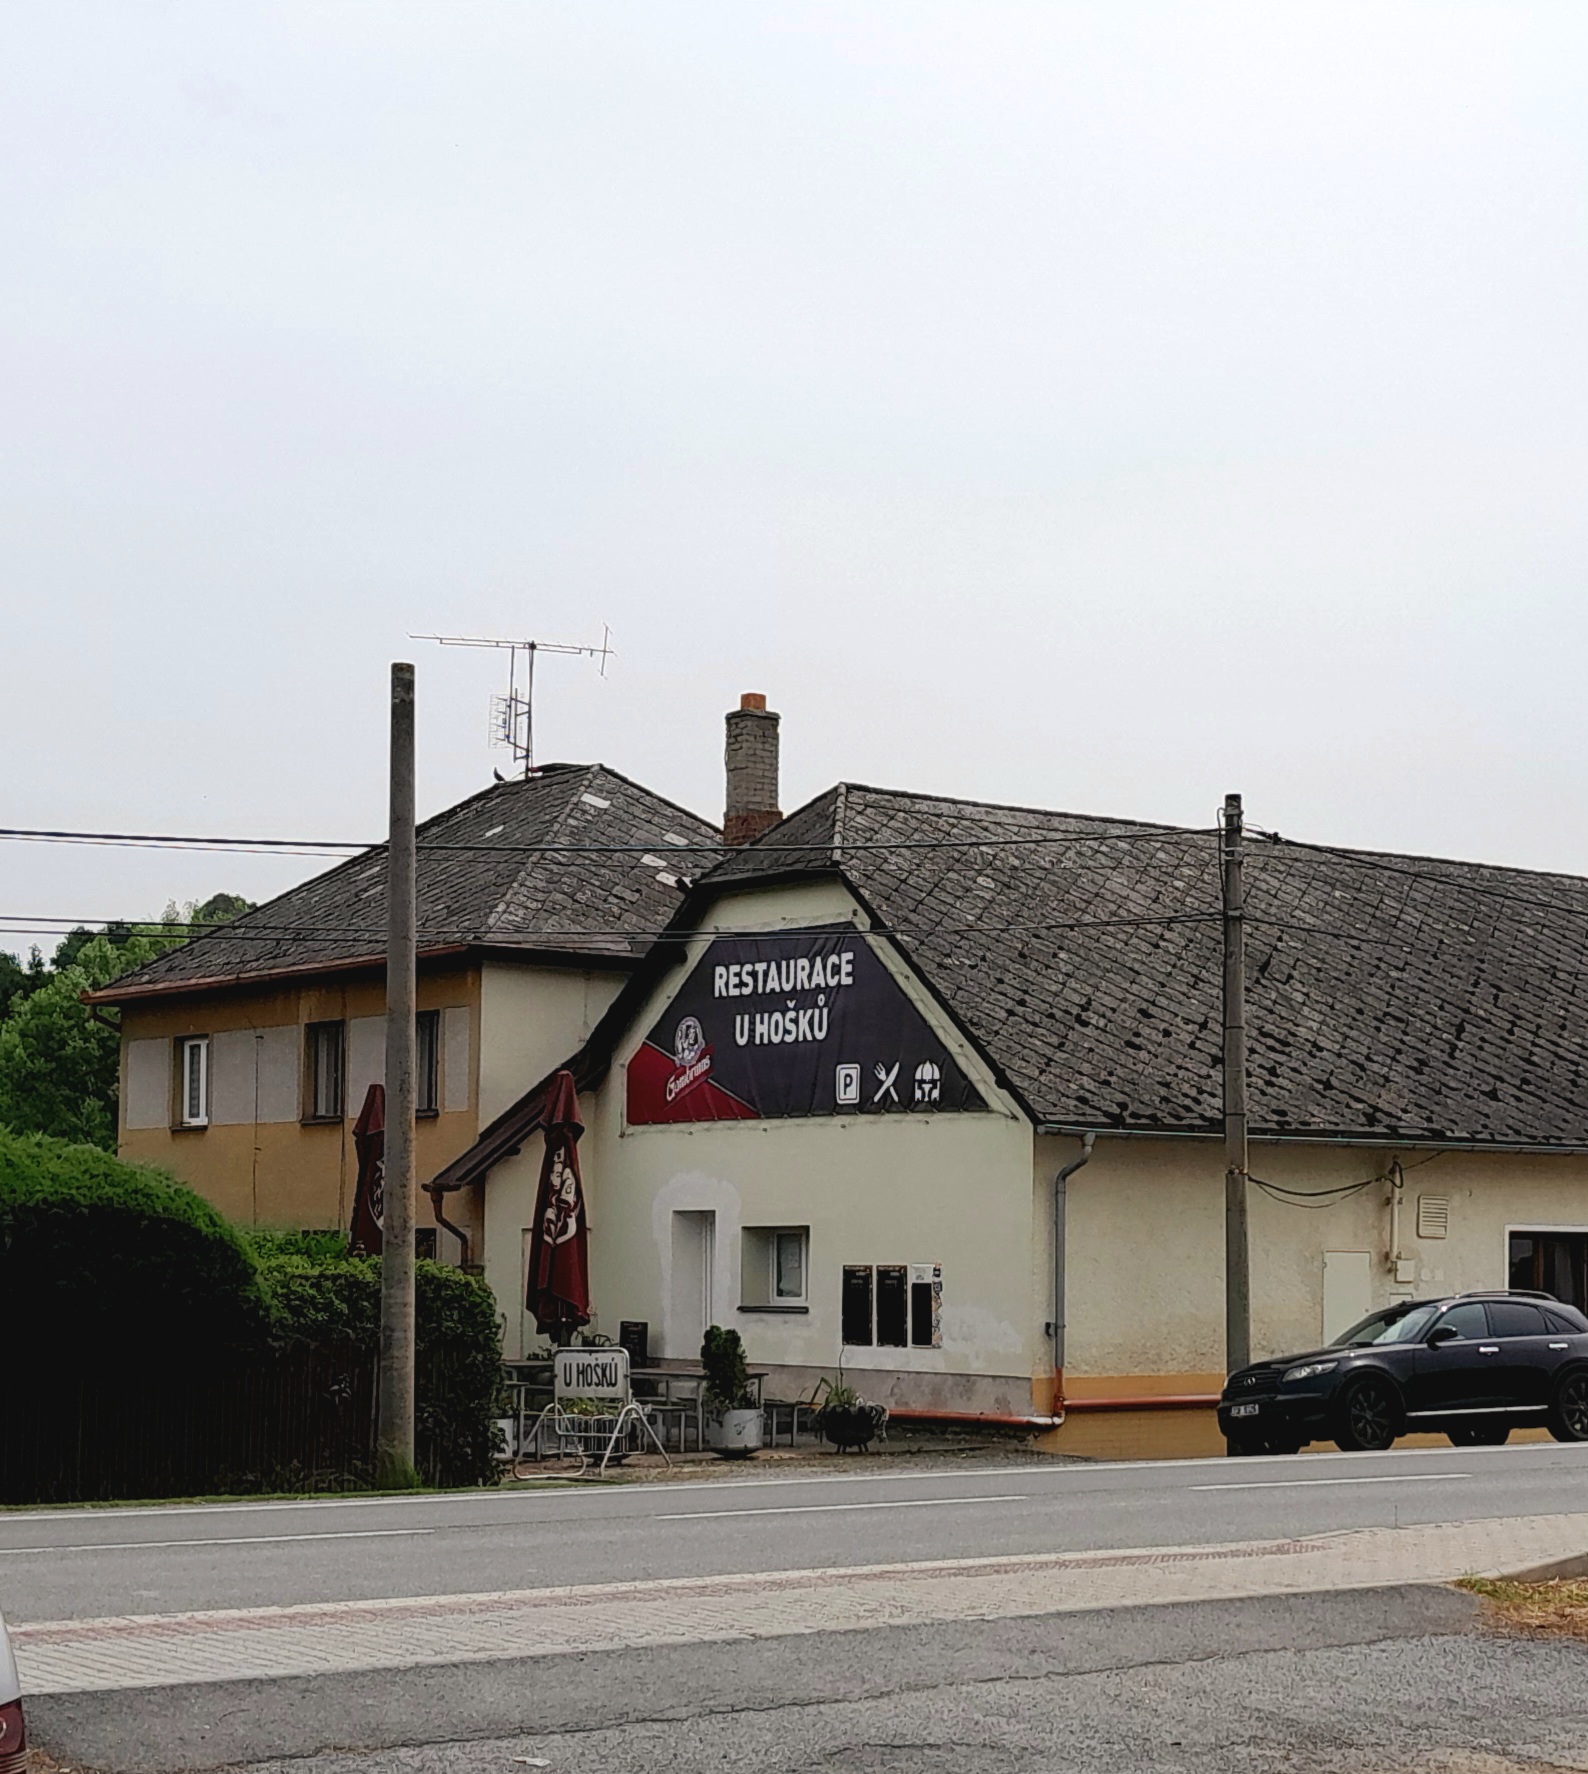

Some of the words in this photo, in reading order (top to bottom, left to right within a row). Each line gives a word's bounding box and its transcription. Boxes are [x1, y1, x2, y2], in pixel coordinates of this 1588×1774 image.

[714, 952, 854, 998] RESTAURACE
[735, 1014, 749, 1046] U
[755, 994, 828, 1045] HOŠKŮ
[563, 1362, 572, 1388] U
